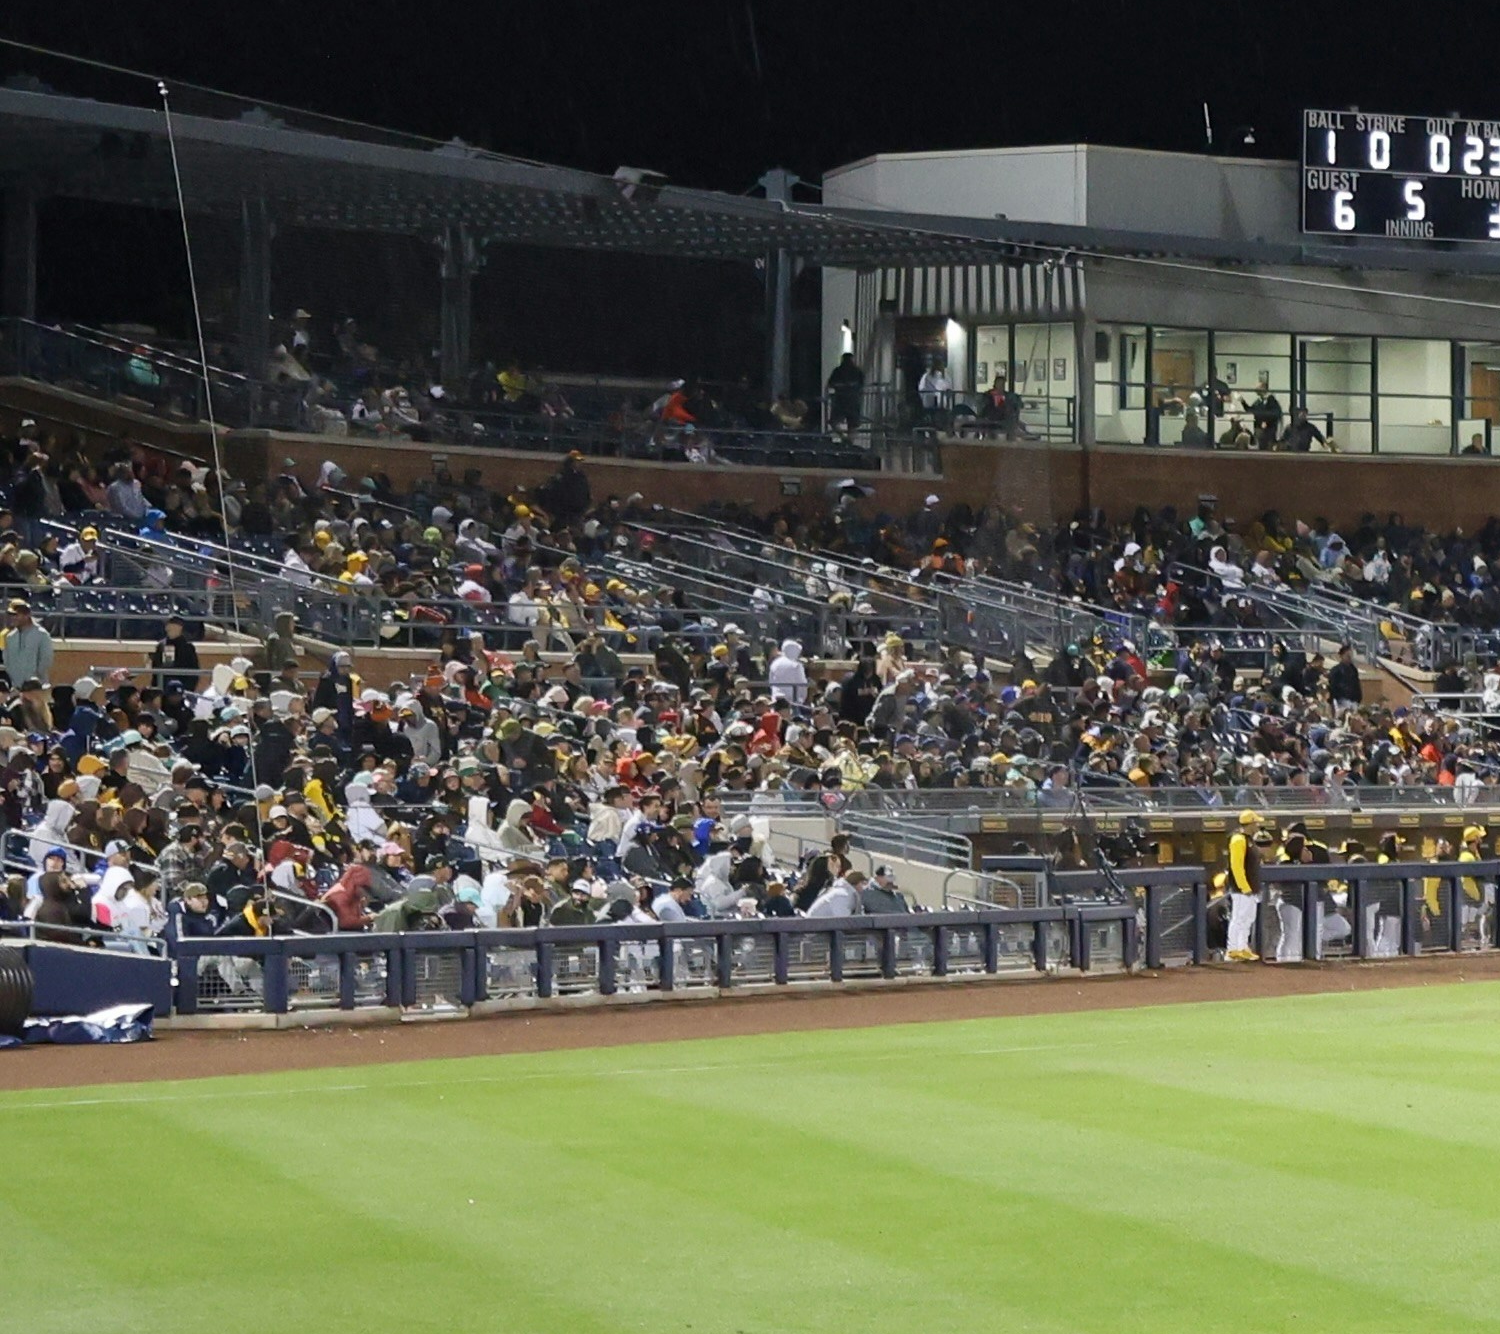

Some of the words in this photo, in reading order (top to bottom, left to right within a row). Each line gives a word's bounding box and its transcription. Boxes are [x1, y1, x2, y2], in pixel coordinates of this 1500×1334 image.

[1308, 112, 1345, 130] BALL
[1356, 114, 1406, 134] STRIKE
[1426, 117, 1455, 136] OUT
[1465, 121, 1480, 138] AT
[1327, 130, 1337, 164] 1
[1369, 130, 1390, 169] 0
[1430, 134, 1451, 173] 0
[1307, 169, 1360, 192] GUEST
[1333, 191, 1356, 231] 6
[1403, 180, 1426, 221] 5
[1385, 219, 1435, 238] INNING
